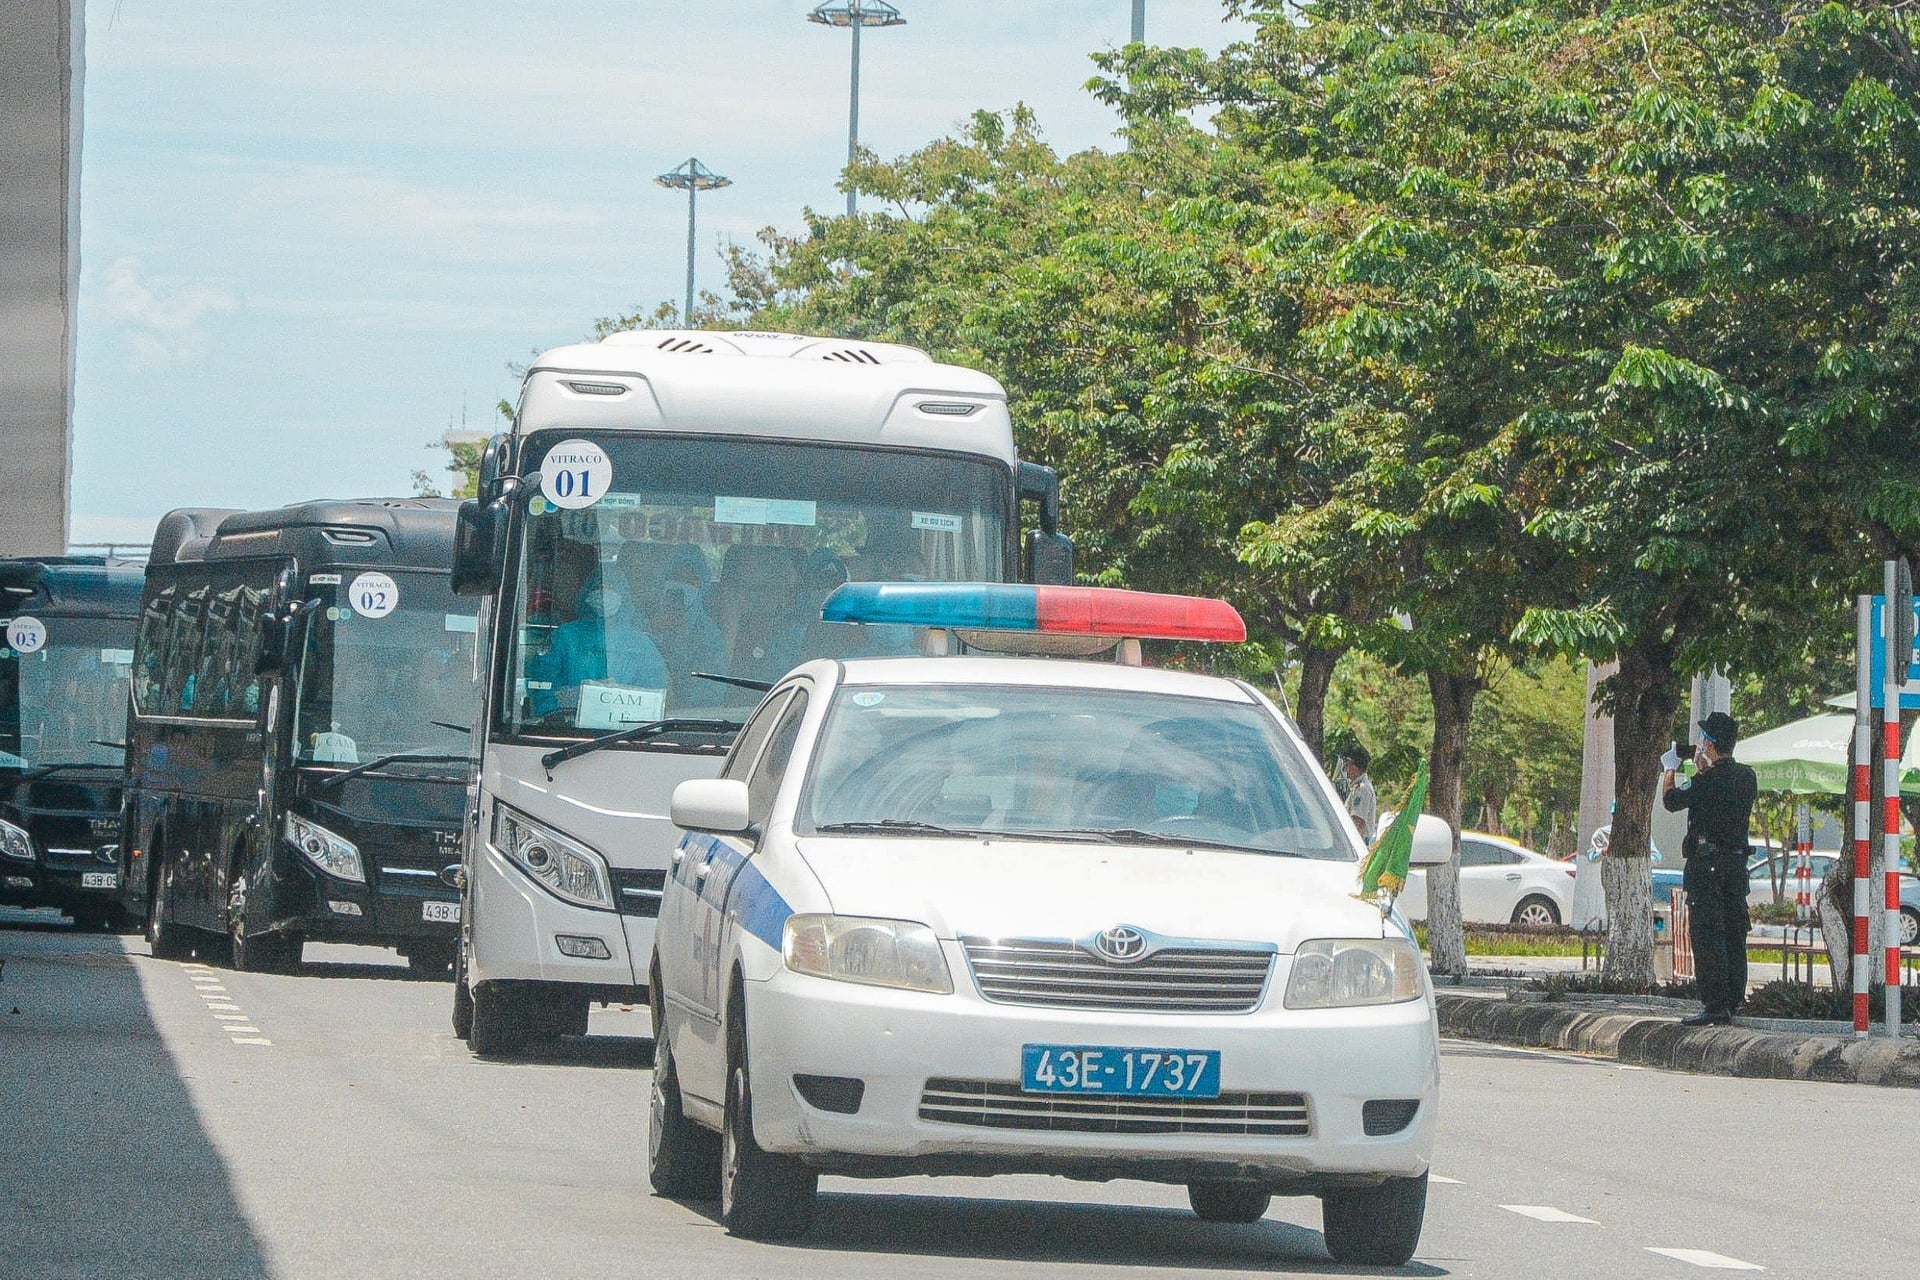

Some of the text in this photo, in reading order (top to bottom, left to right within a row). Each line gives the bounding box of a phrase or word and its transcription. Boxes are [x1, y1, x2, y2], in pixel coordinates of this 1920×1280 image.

[550, 455, 602, 464] VITRACO
[555, 469, 592, 498] 01
[360, 591, 386, 611] 02
[16, 631, 36, 647] 03
[599, 691, 642, 706] CAM
[88, 819, 120, 828] THA
[1035, 1050, 1208, 1091] 43E-1737
